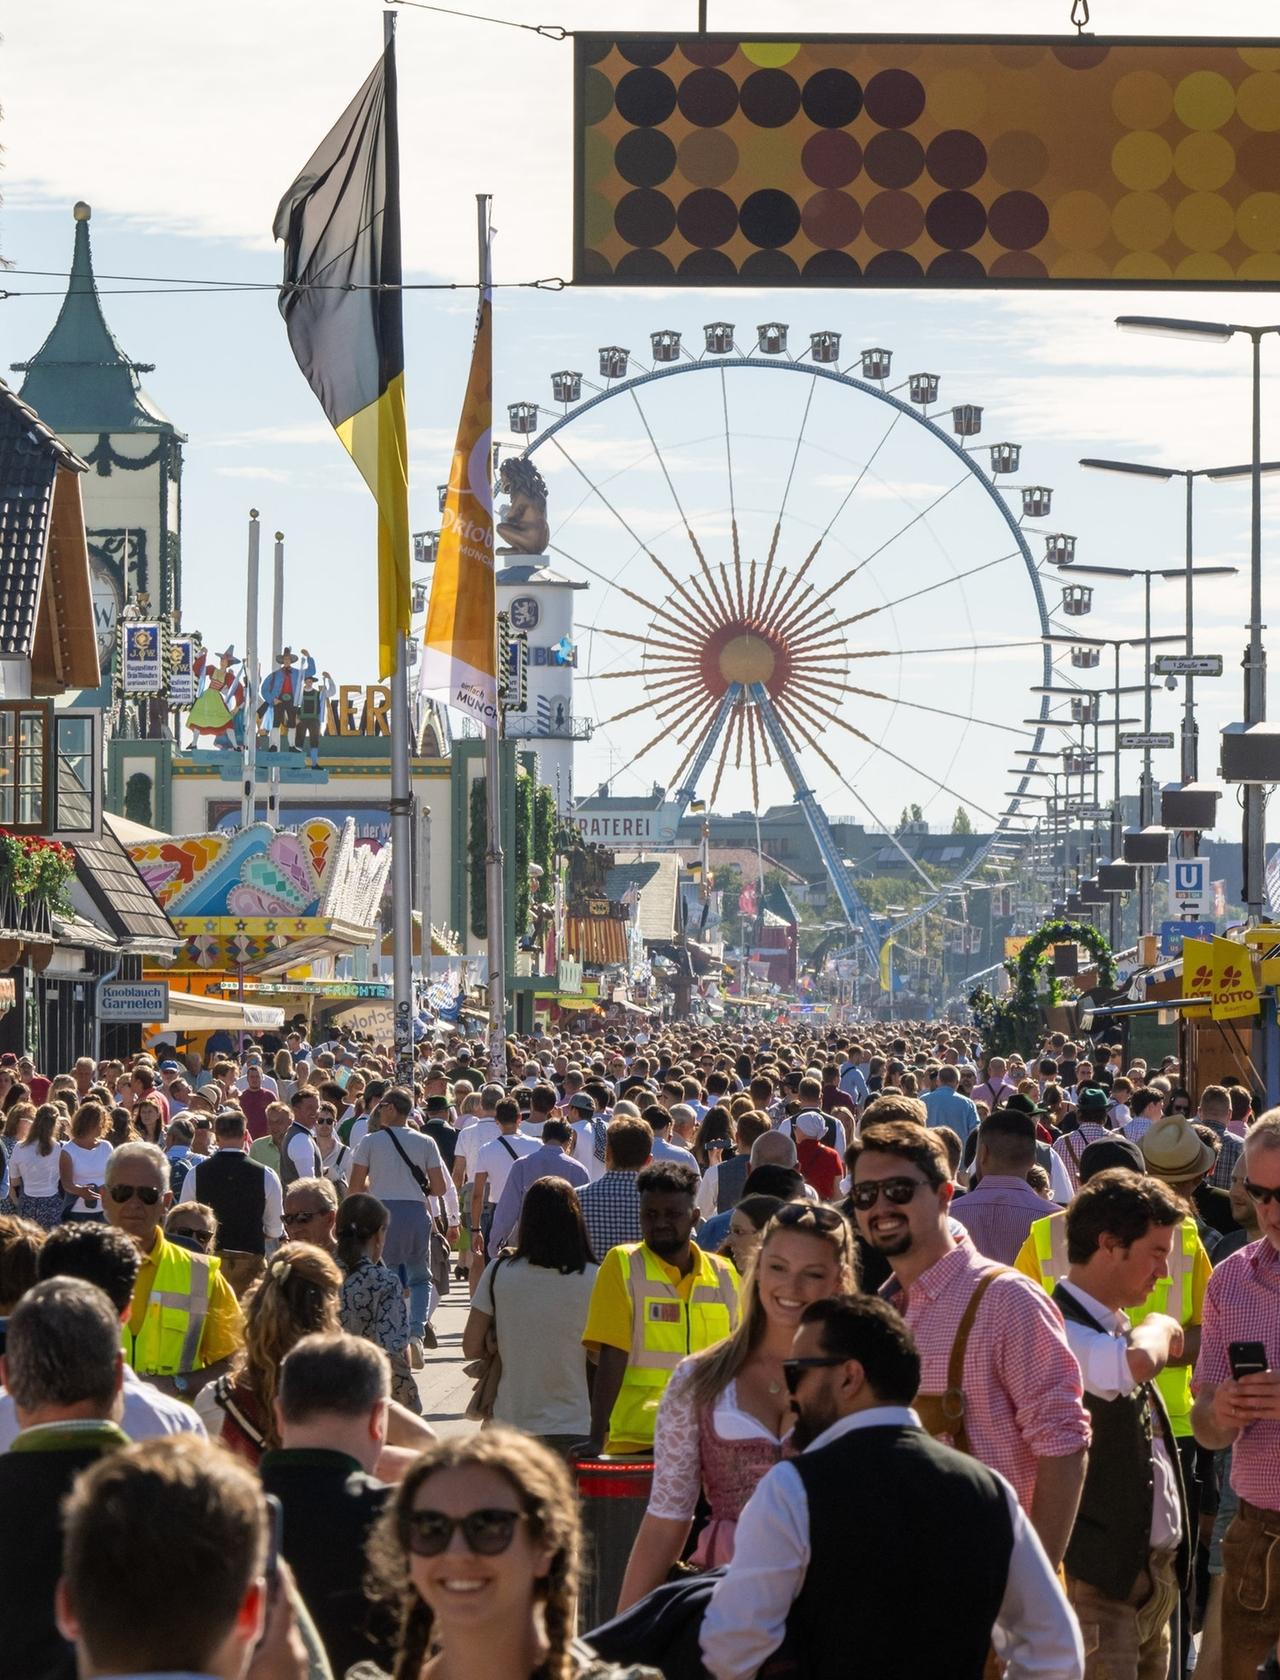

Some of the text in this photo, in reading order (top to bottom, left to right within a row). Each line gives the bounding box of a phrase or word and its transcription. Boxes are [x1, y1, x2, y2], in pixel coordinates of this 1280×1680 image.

[443, 507, 494, 548] Oktob
[460, 544, 494, 567] MÜNCH
[457, 690, 497, 720] MÜNCH
[567, 818, 649, 837] RATEREI
[1180, 866, 1198, 888] U
[103, 988, 161, 998] Knoblauch
[325, 984, 386, 998] FRÜCHTE
[1214, 990, 1254, 1005] LOTTO
[102, 998, 162, 1009] Garnelen
